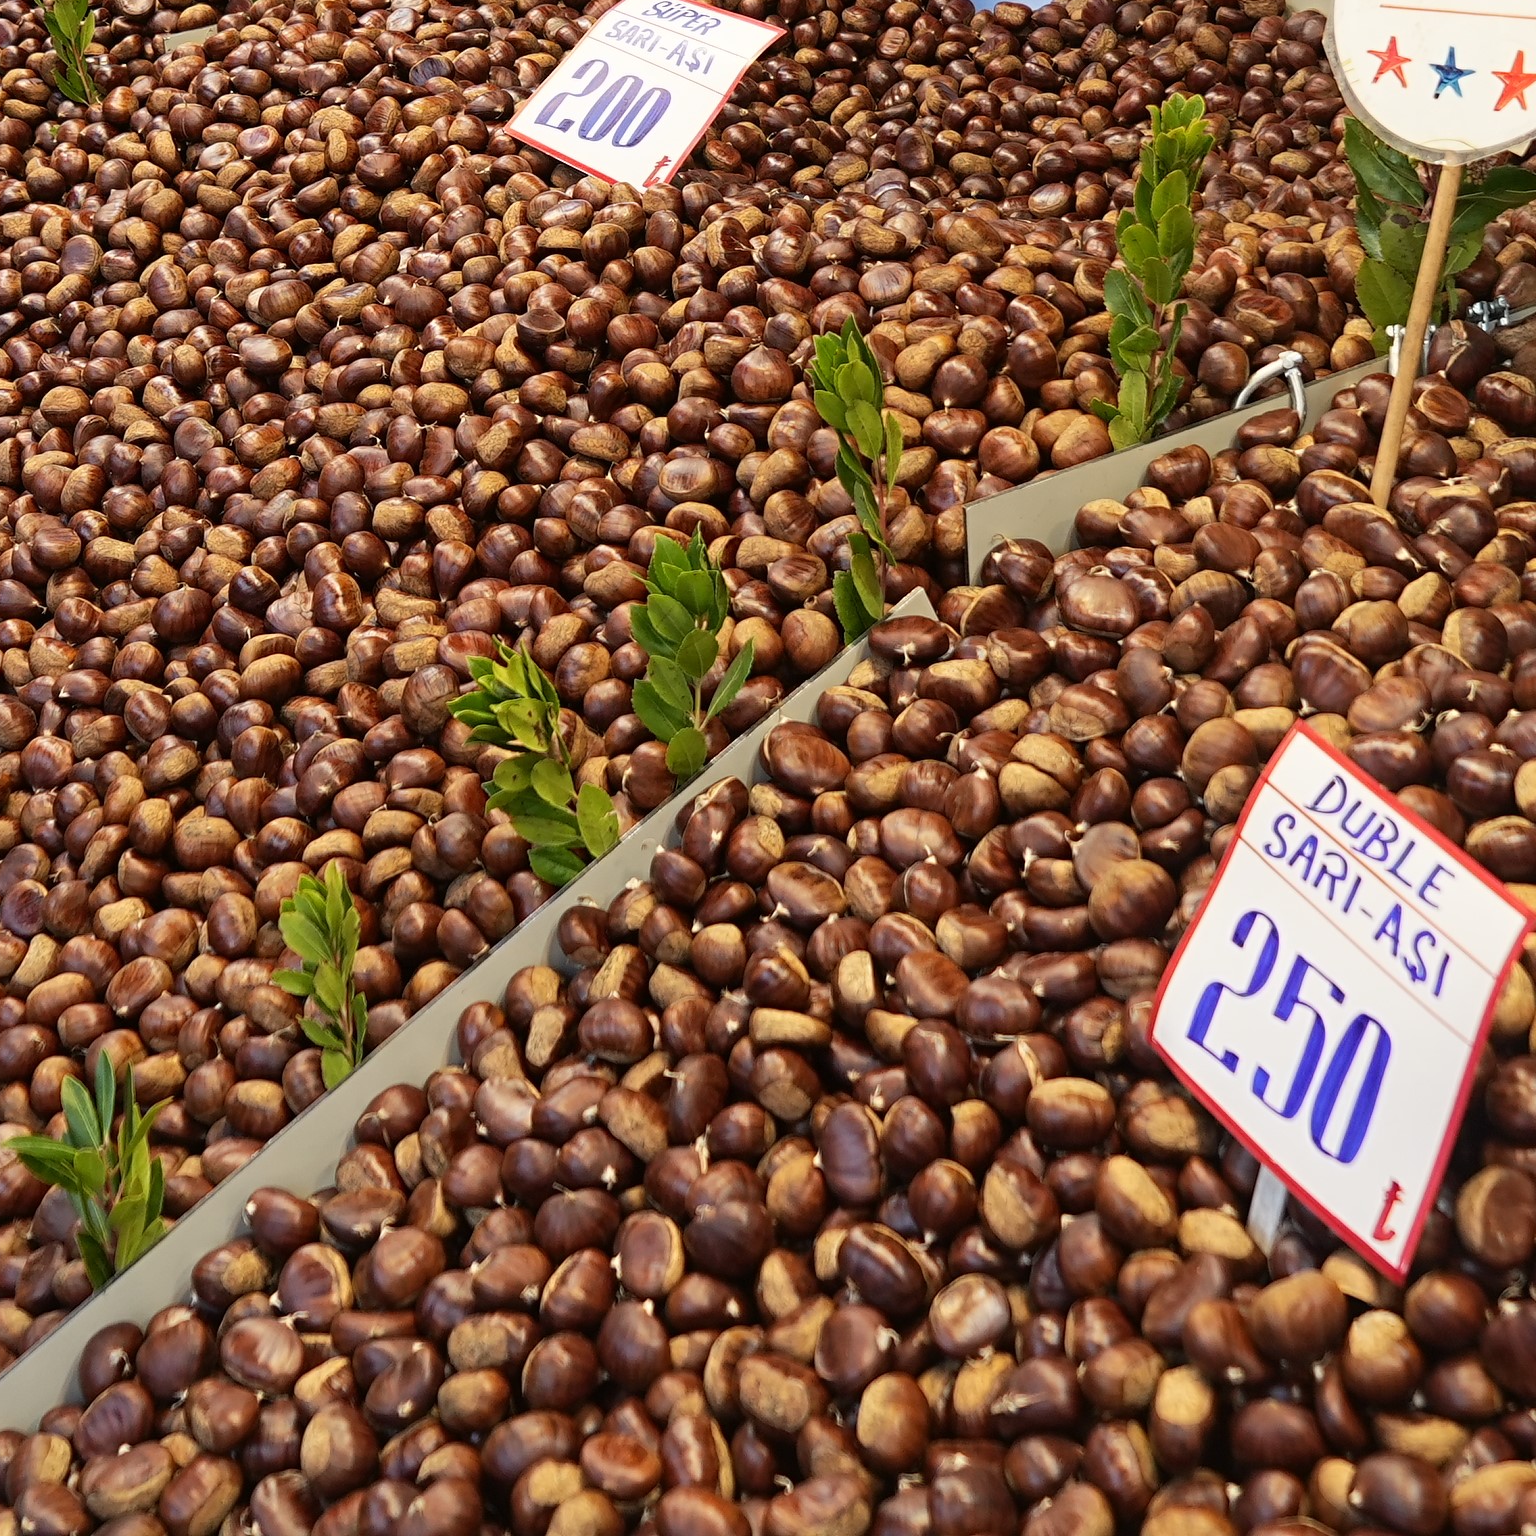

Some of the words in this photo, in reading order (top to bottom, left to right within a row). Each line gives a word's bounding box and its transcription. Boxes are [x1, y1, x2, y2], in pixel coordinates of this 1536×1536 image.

[605, 19, 715, 75] SARI-AŞI
[641, 0, 722, 36] SÜPER
[534, 58, 672, 148] 200
[1305, 774, 1457, 910] DUBLE
[1263, 812, 1452, 998] SARI-AŞI
[1185, 909, 1393, 1166] 250
